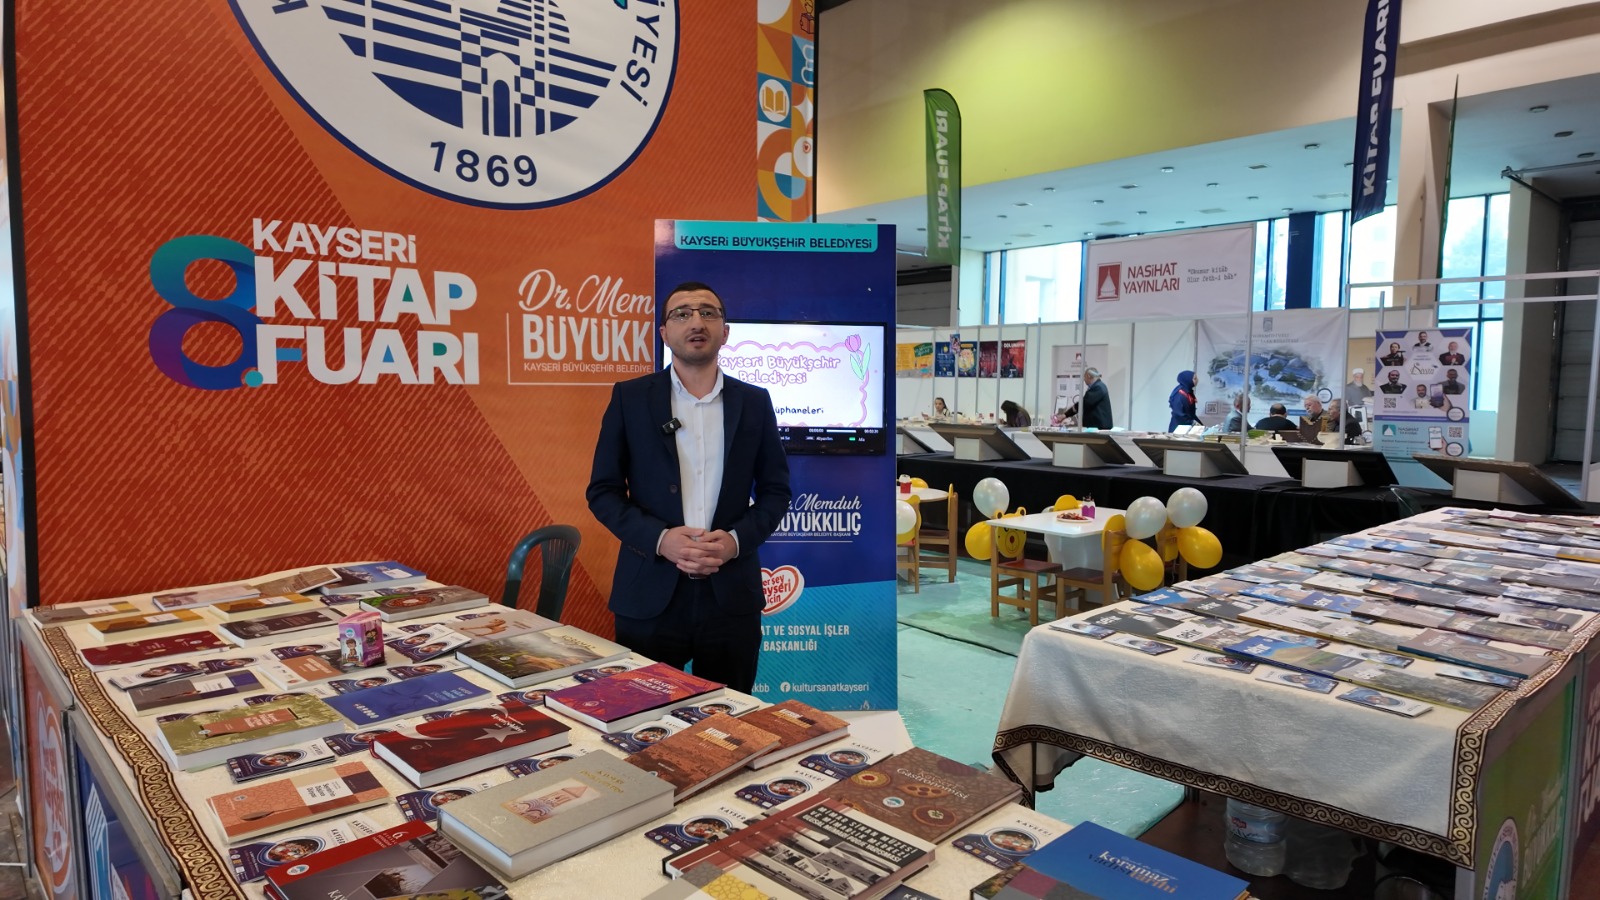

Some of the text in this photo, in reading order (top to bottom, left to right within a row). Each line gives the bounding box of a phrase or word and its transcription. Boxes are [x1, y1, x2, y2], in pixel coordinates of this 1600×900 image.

[430, 141, 538, 187] 1869
[252, 217, 417, 264] KAYSERİ
[680, 235, 872, 249] KAYSERİ BÜYÜKŞEHİR BELEDİYESİ
[1127, 262, 1178, 279] NASİHAT
[254, 255, 478, 326] KİTAP
[518, 268, 655, 318] Dr. Mem
[1123, 277, 1180, 294] YAYINLARI
[522, 313, 655, 363] BÜYÜKK
[255, 324, 480, 385] FUARI
[767, 354, 841, 371] Büyükşehir
[523, 361, 652, 374] KAYSERİ BÜYÜKŞEHİR BELEDİYE
[738, 369, 807, 386] Belediyesi
[775, 405, 824, 415] üphaneleri
[795, 493, 862, 511] Memduh
[762, 574, 785, 587] er şey
[763, 579, 791, 596] ayseri
[766, 594, 781, 605] için
[773, 625, 785, 635] VE
[788, 625, 822, 636] SOSYAL
[824, 623, 850, 637] İŞLER
[763, 638, 818, 653] BAŞKANLIĞI
[792, 681, 869, 693] kultursanatkayseri
[719, 806, 747, 821] KAYSER
[809, 810, 911, 859] VE MİMARLIK MERKEZİ
[817, 806, 919, 854] MİMAR SİNAN MÜZESİ
[1099, 850, 1170, 882] koramaz
